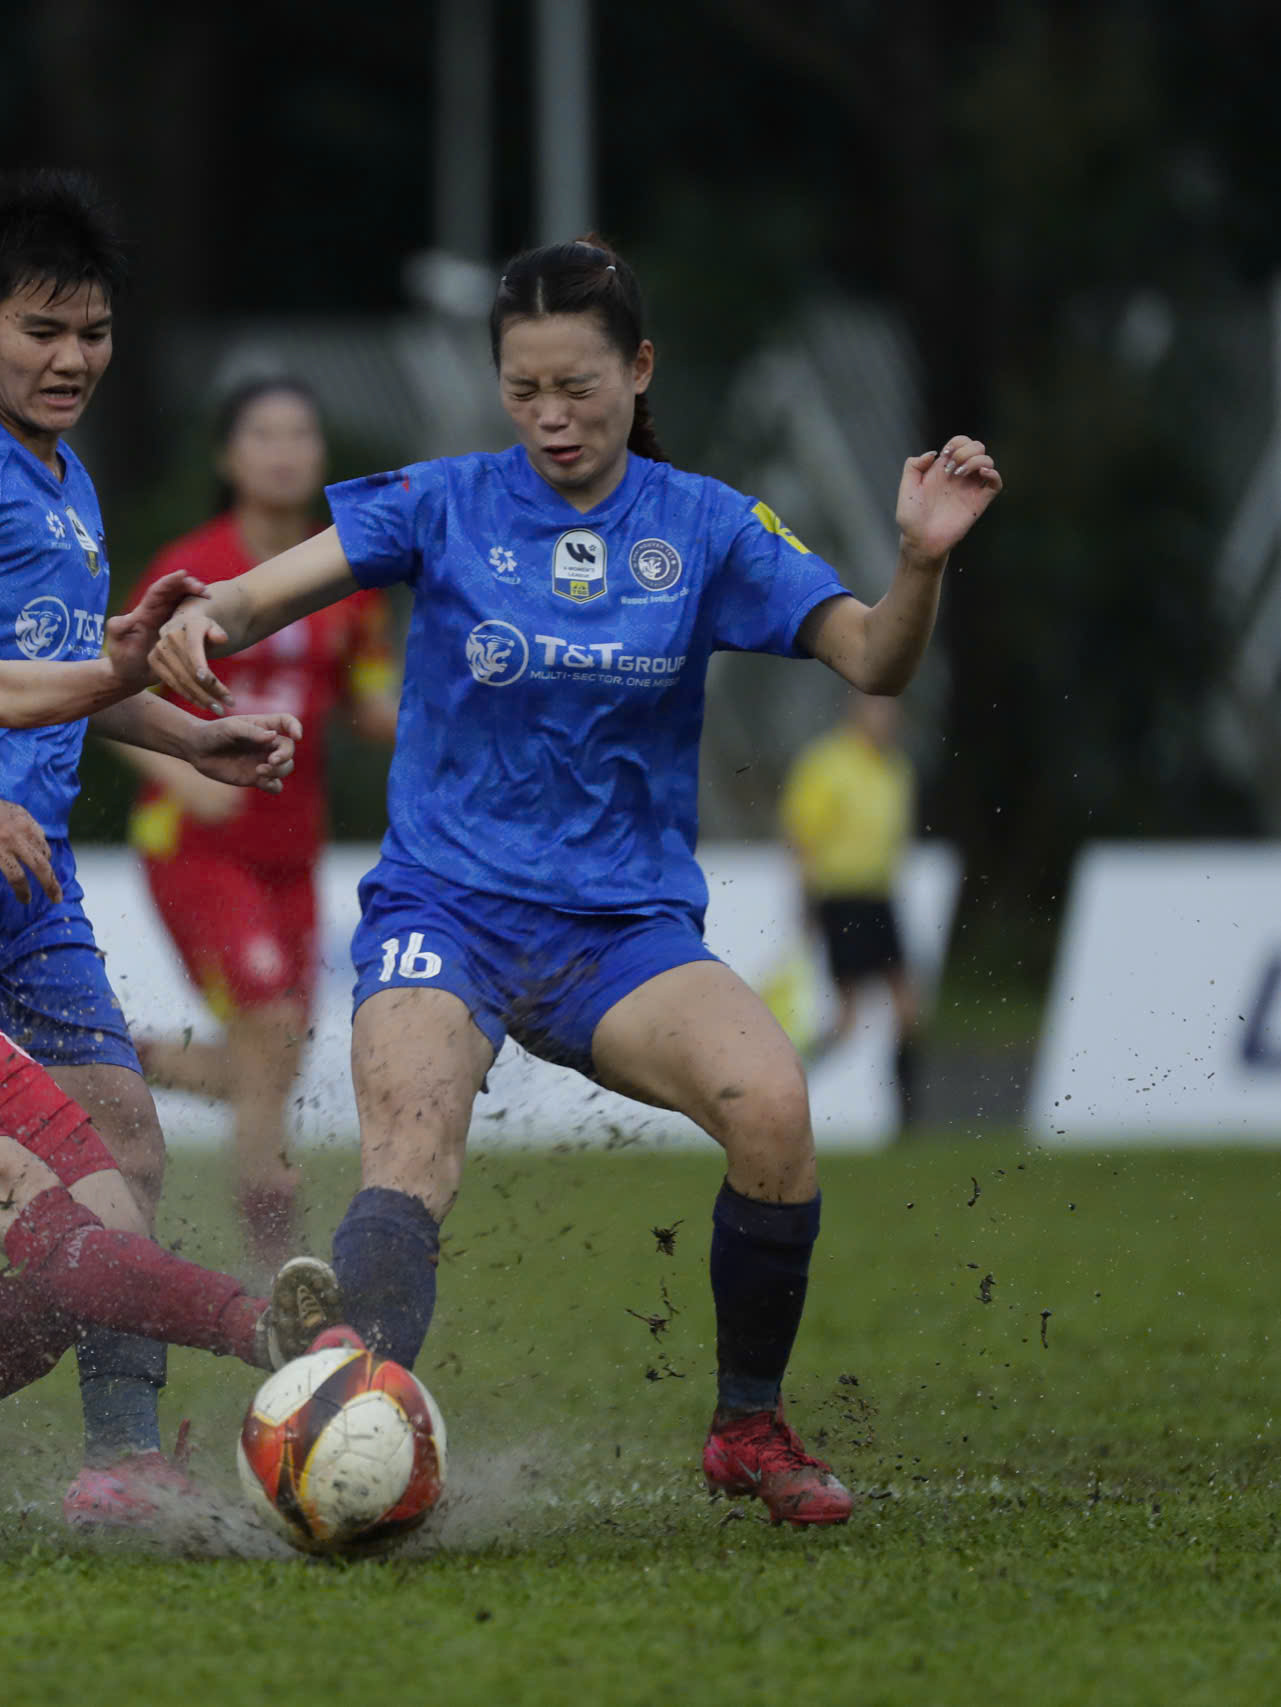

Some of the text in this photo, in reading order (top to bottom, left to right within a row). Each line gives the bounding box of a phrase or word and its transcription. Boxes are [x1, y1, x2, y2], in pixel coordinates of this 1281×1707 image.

[535, 634, 687, 674] T&T GROUP
[626, 676, 651, 688] ONE
[379, 931, 443, 983] 16
